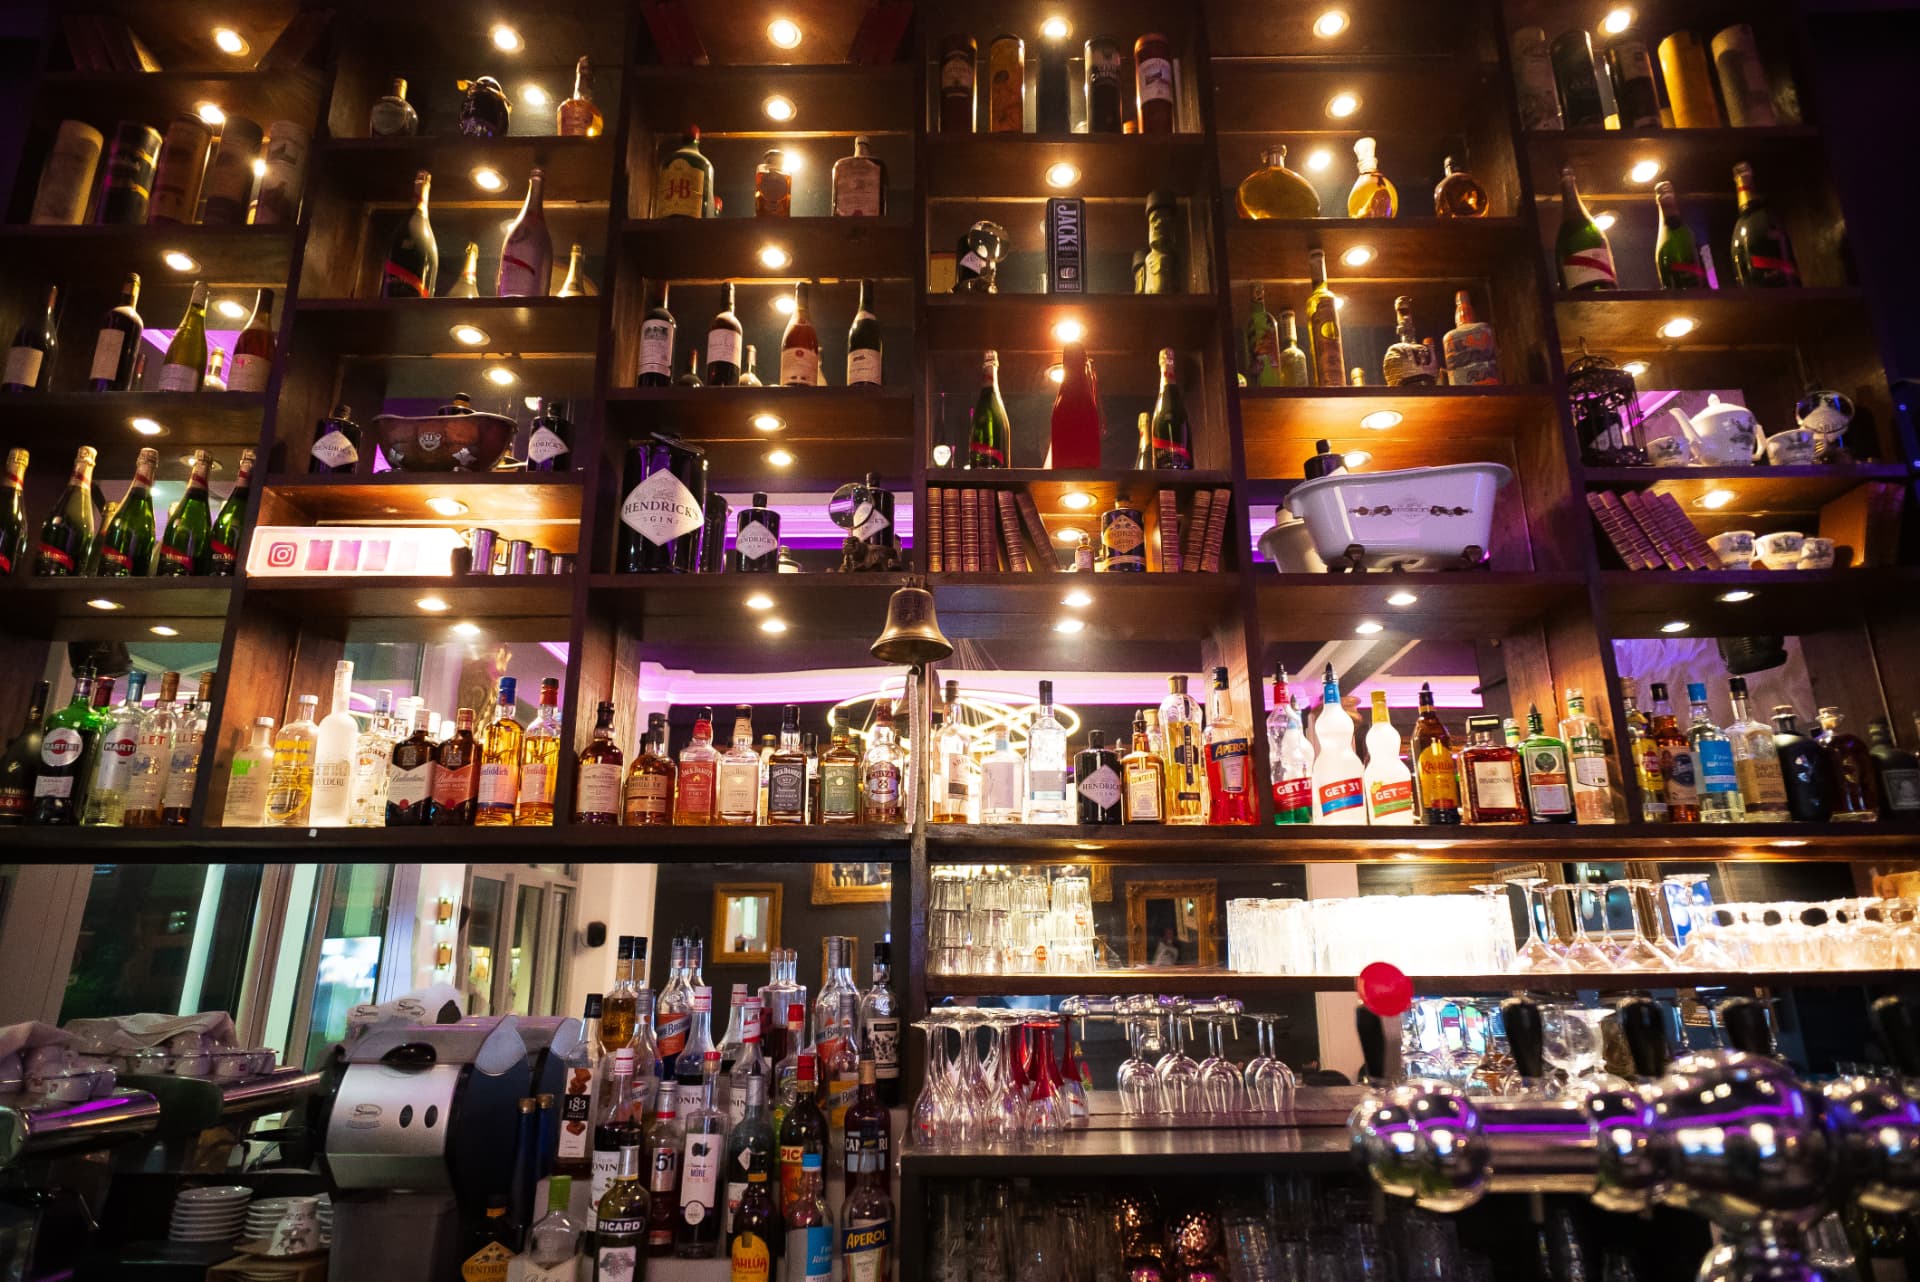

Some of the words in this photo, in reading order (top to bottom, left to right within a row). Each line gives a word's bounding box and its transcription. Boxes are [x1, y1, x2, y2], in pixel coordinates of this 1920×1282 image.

[1057, 205, 1078, 246] JACK
[624, 501, 699, 520] HENDRICK'S
[1277, 782, 1300, 795] GET
[1325, 783, 1347, 797] GET
[1348, 781, 1360, 792] 31
[1375, 788, 1398, 801] GET
[655, 1152, 675, 1172] 51
[845, 1229, 887, 1250] APEROL
